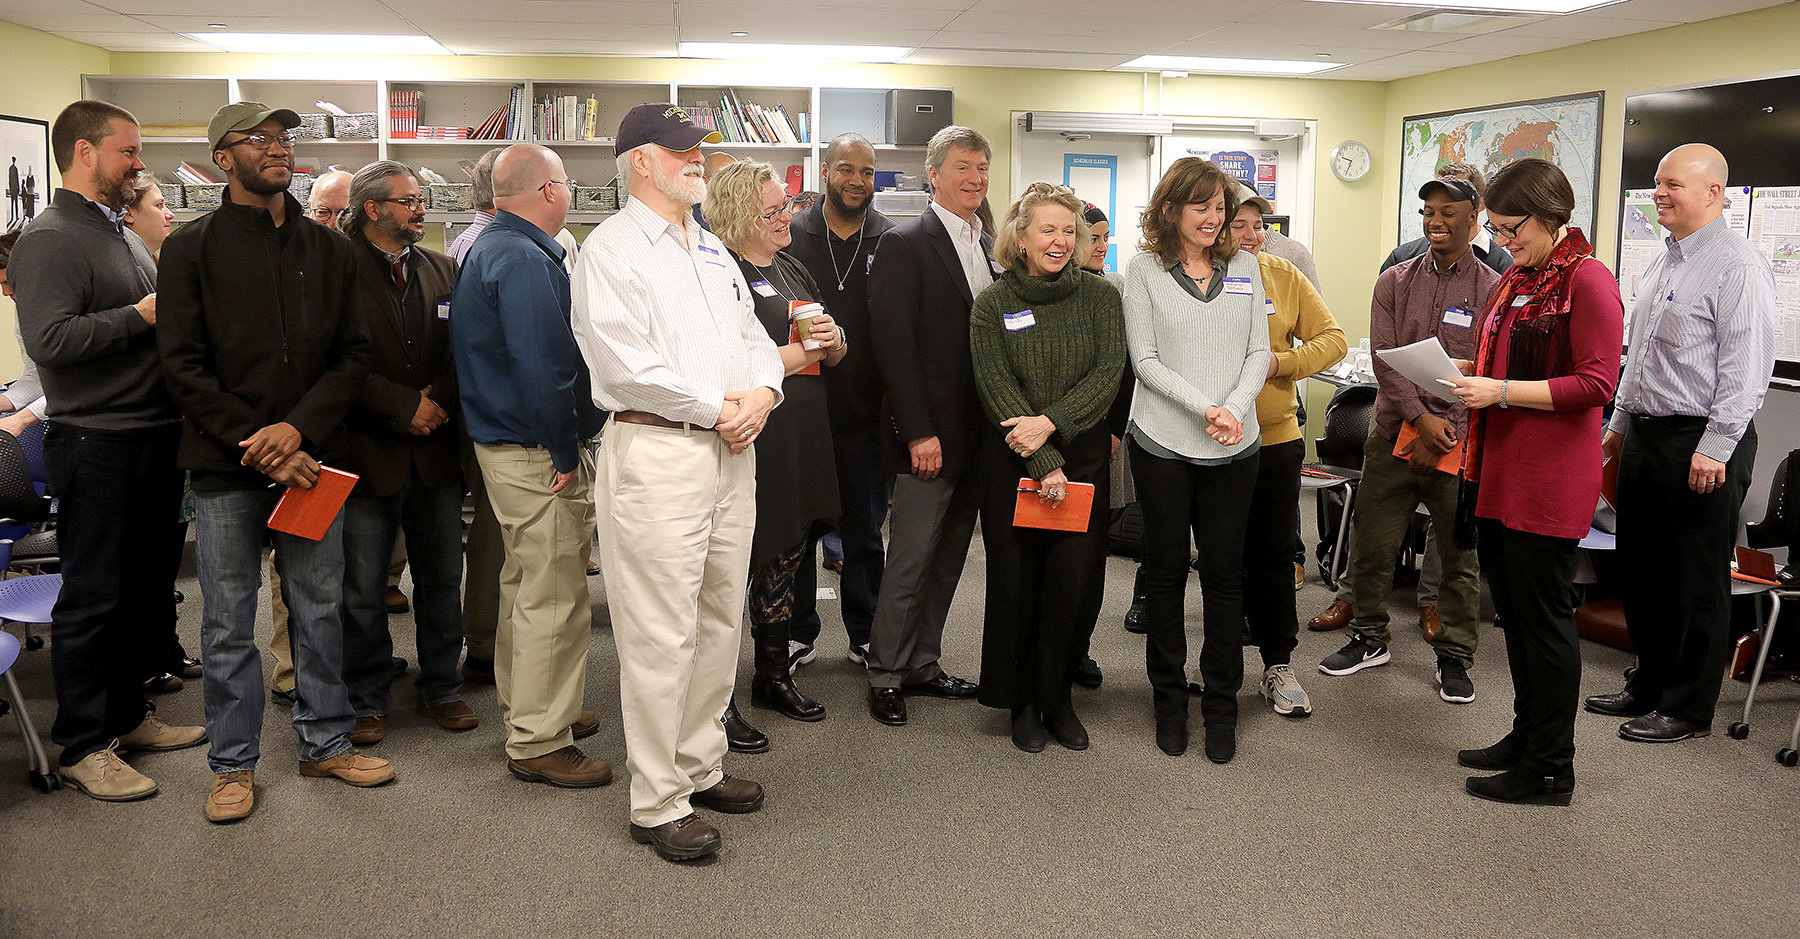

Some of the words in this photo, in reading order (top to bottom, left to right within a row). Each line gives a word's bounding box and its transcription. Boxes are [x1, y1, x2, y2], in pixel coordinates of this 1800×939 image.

[1220, 161, 1245, 170] SHARE-
[1221, 169, 1249, 178] ORTHY?
[1767, 190, 1779, 198] WALL
[1779, 190, 1797, 198] STREET
